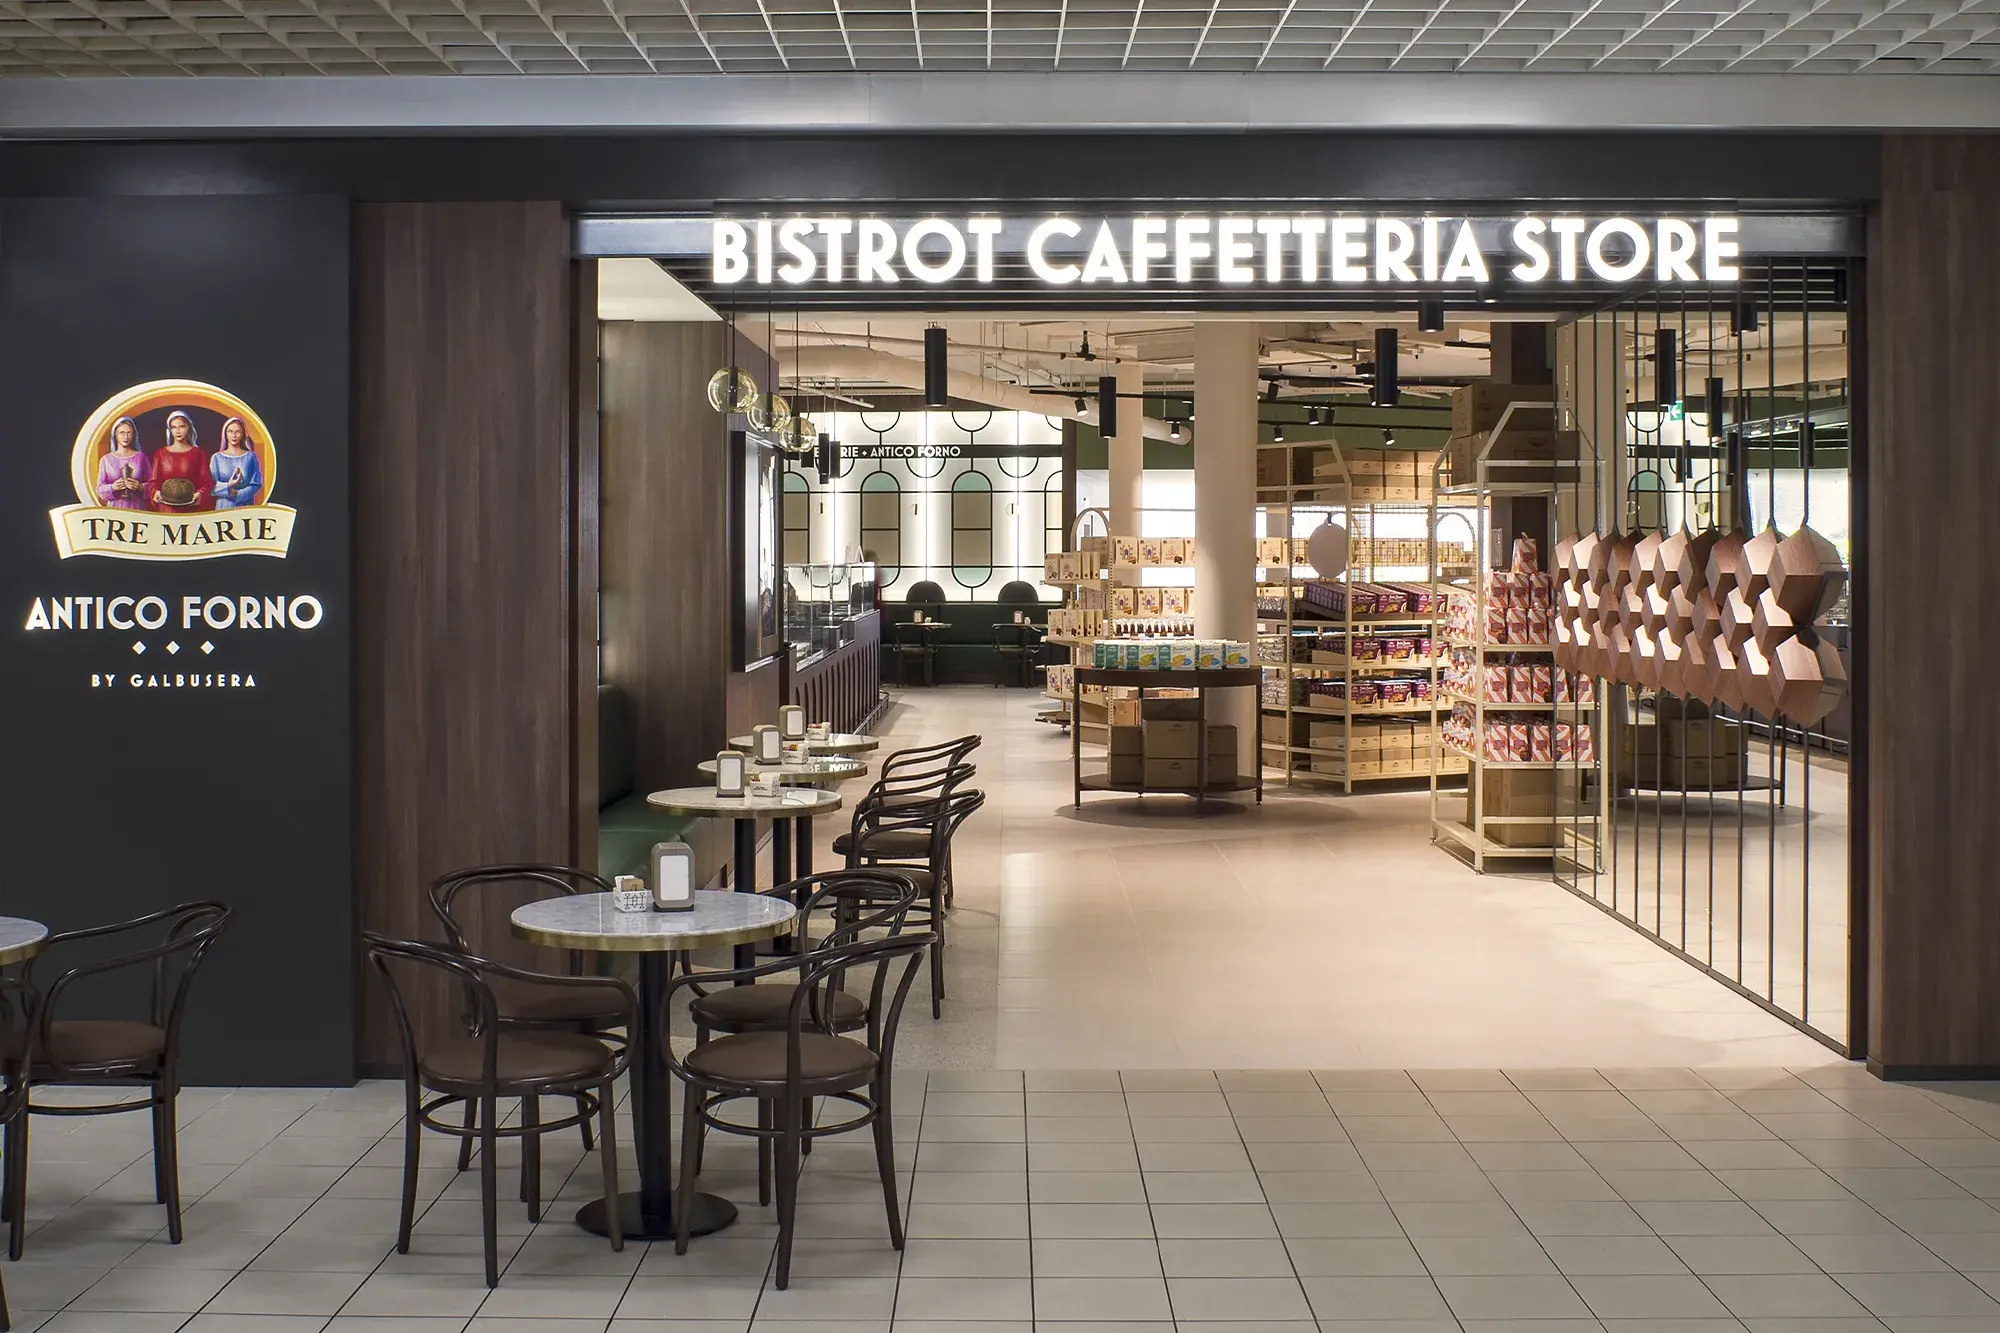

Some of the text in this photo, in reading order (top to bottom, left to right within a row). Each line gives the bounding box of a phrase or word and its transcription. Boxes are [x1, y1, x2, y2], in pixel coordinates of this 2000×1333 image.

[713, 217, 1739, 284] BISTROT CAFFETTERIA STORE
[870, 446, 915, 457] ANTICO
[917, 445, 961, 457] FORNO
[82, 517, 277, 546] TRE MARIE
[25, 595, 323, 630] ANTICO FORNO
[91, 673, 257, 688] BY GALBUSERA
